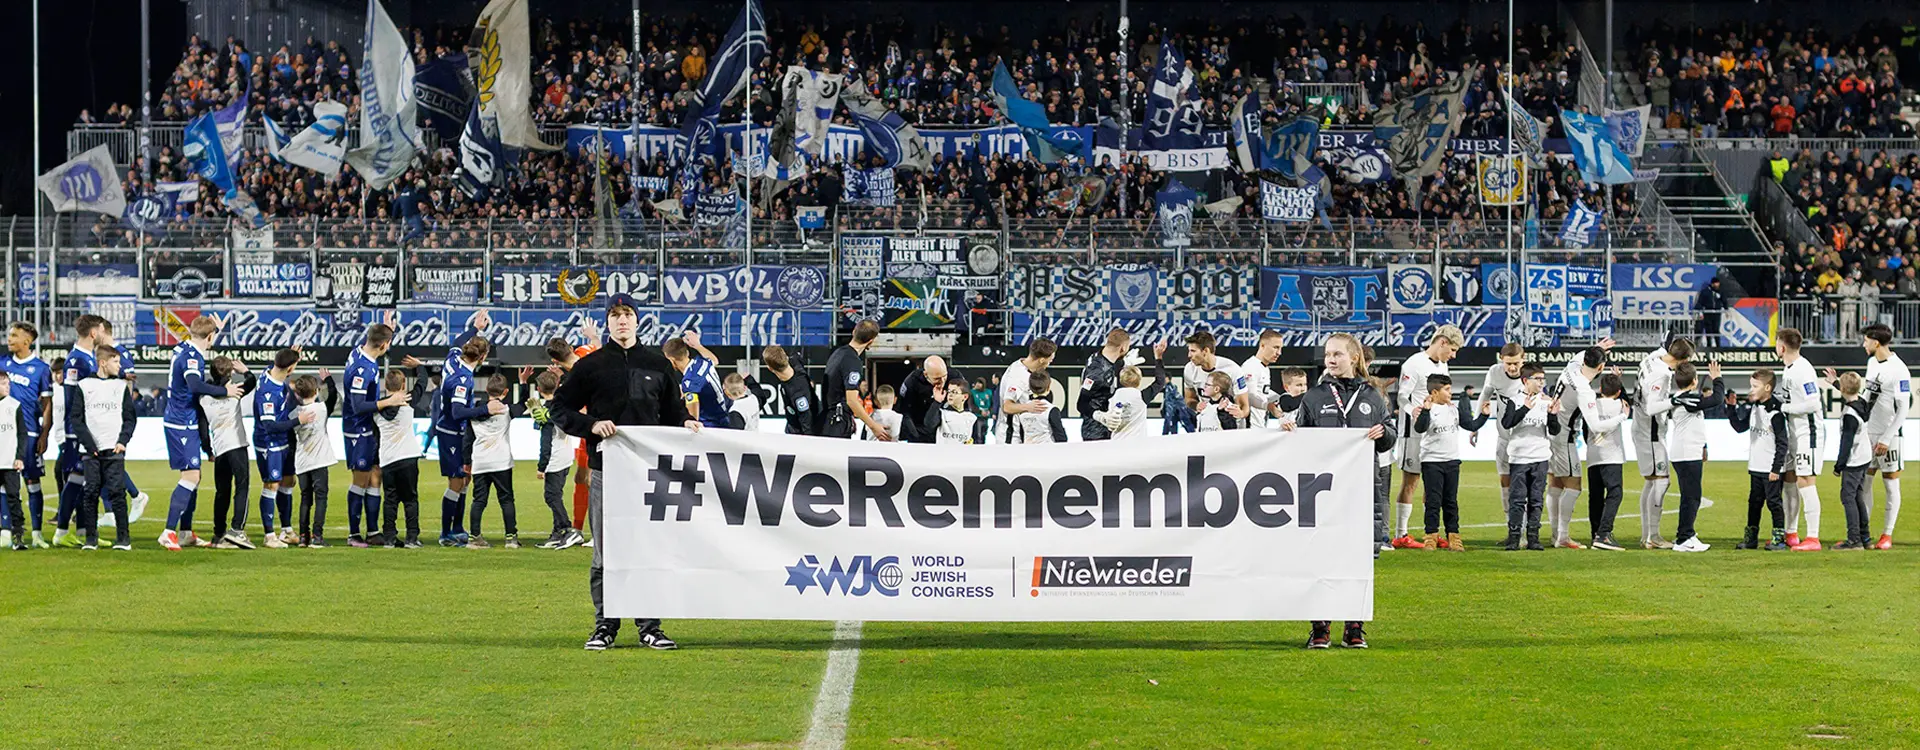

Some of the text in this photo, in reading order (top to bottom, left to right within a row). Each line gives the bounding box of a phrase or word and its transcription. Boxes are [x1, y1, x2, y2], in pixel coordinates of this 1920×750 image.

[1168, 153, 1214, 168] BIST
[1262, 181, 1317, 197] ULTRAS
[1262, 193, 1315, 208] ARMATA
[1262, 206, 1315, 220] FIDELIS
[1567, 209, 1596, 234] 12
[843, 238, 882, 246] NERVEN
[889, 238, 937, 250] FREIHEIT
[843, 248, 881, 257] KLINIK
[891, 250, 960, 262] ALEX UND M.
[235, 264, 278, 279] BADEN
[1568, 271, 1590, 284] BW
[1633, 266, 1695, 289] KSC
[939, 277, 997, 288] KARLSRUHE
[1315, 279, 1345, 287] ULTRAS
[1528, 268, 1564, 290] ZS
[238, 279, 310, 294] KOLLEKTIV
[503, 271, 650, 302] RF 02
[1530, 303, 1565, 324] KA
[740, 311, 784, 346] KSC
[1709, 352, 1757, 362] UNSERE
[1795, 453, 1811, 466] 24
[644, 452, 1333, 530] #WeRemember
[912, 555, 965, 567] WORLD
[911, 571, 967, 583] JEWISH
[911, 586, 994, 598] CONGRESS
